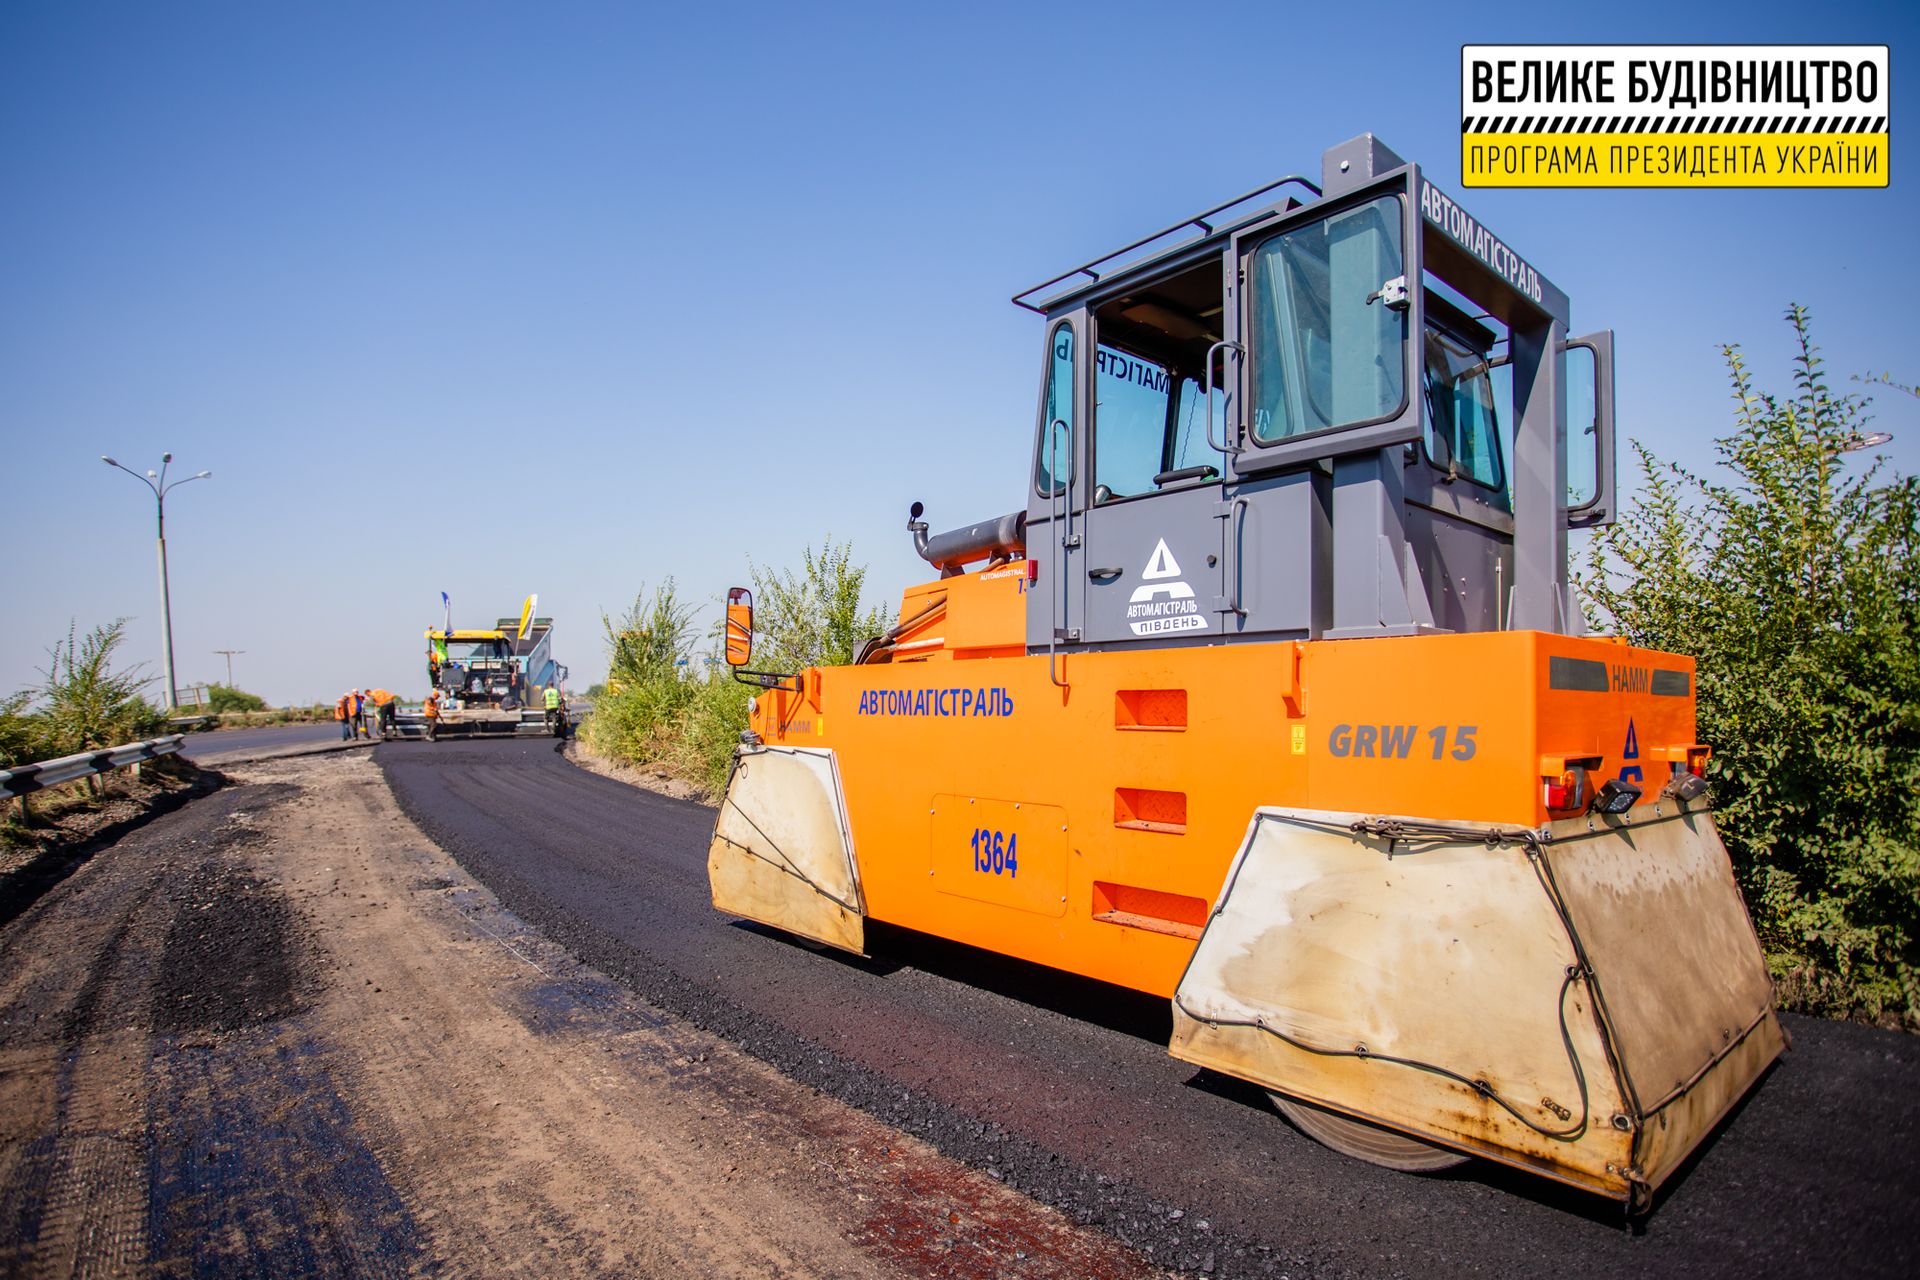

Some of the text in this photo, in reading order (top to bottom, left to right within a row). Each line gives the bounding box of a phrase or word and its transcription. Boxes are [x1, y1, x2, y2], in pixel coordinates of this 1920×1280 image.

[1421, 181, 1542, 303] АВТОМАГІСТРАЛЬ
[980, 569, 1025, 580] AUTOMAGISTRAL
[1127, 600, 1198, 618] АВТОМАГІСТРАЛЬ
[1140, 617, 1199, 633] ПІВДЕНЬ
[1612, 664, 1648, 694] HAMM
[858, 687, 1014, 717] АВТОМАГІСТРАЛЬ
[1328, 723, 1478, 761] GRW 15
[971, 827, 1018, 878] 1364
